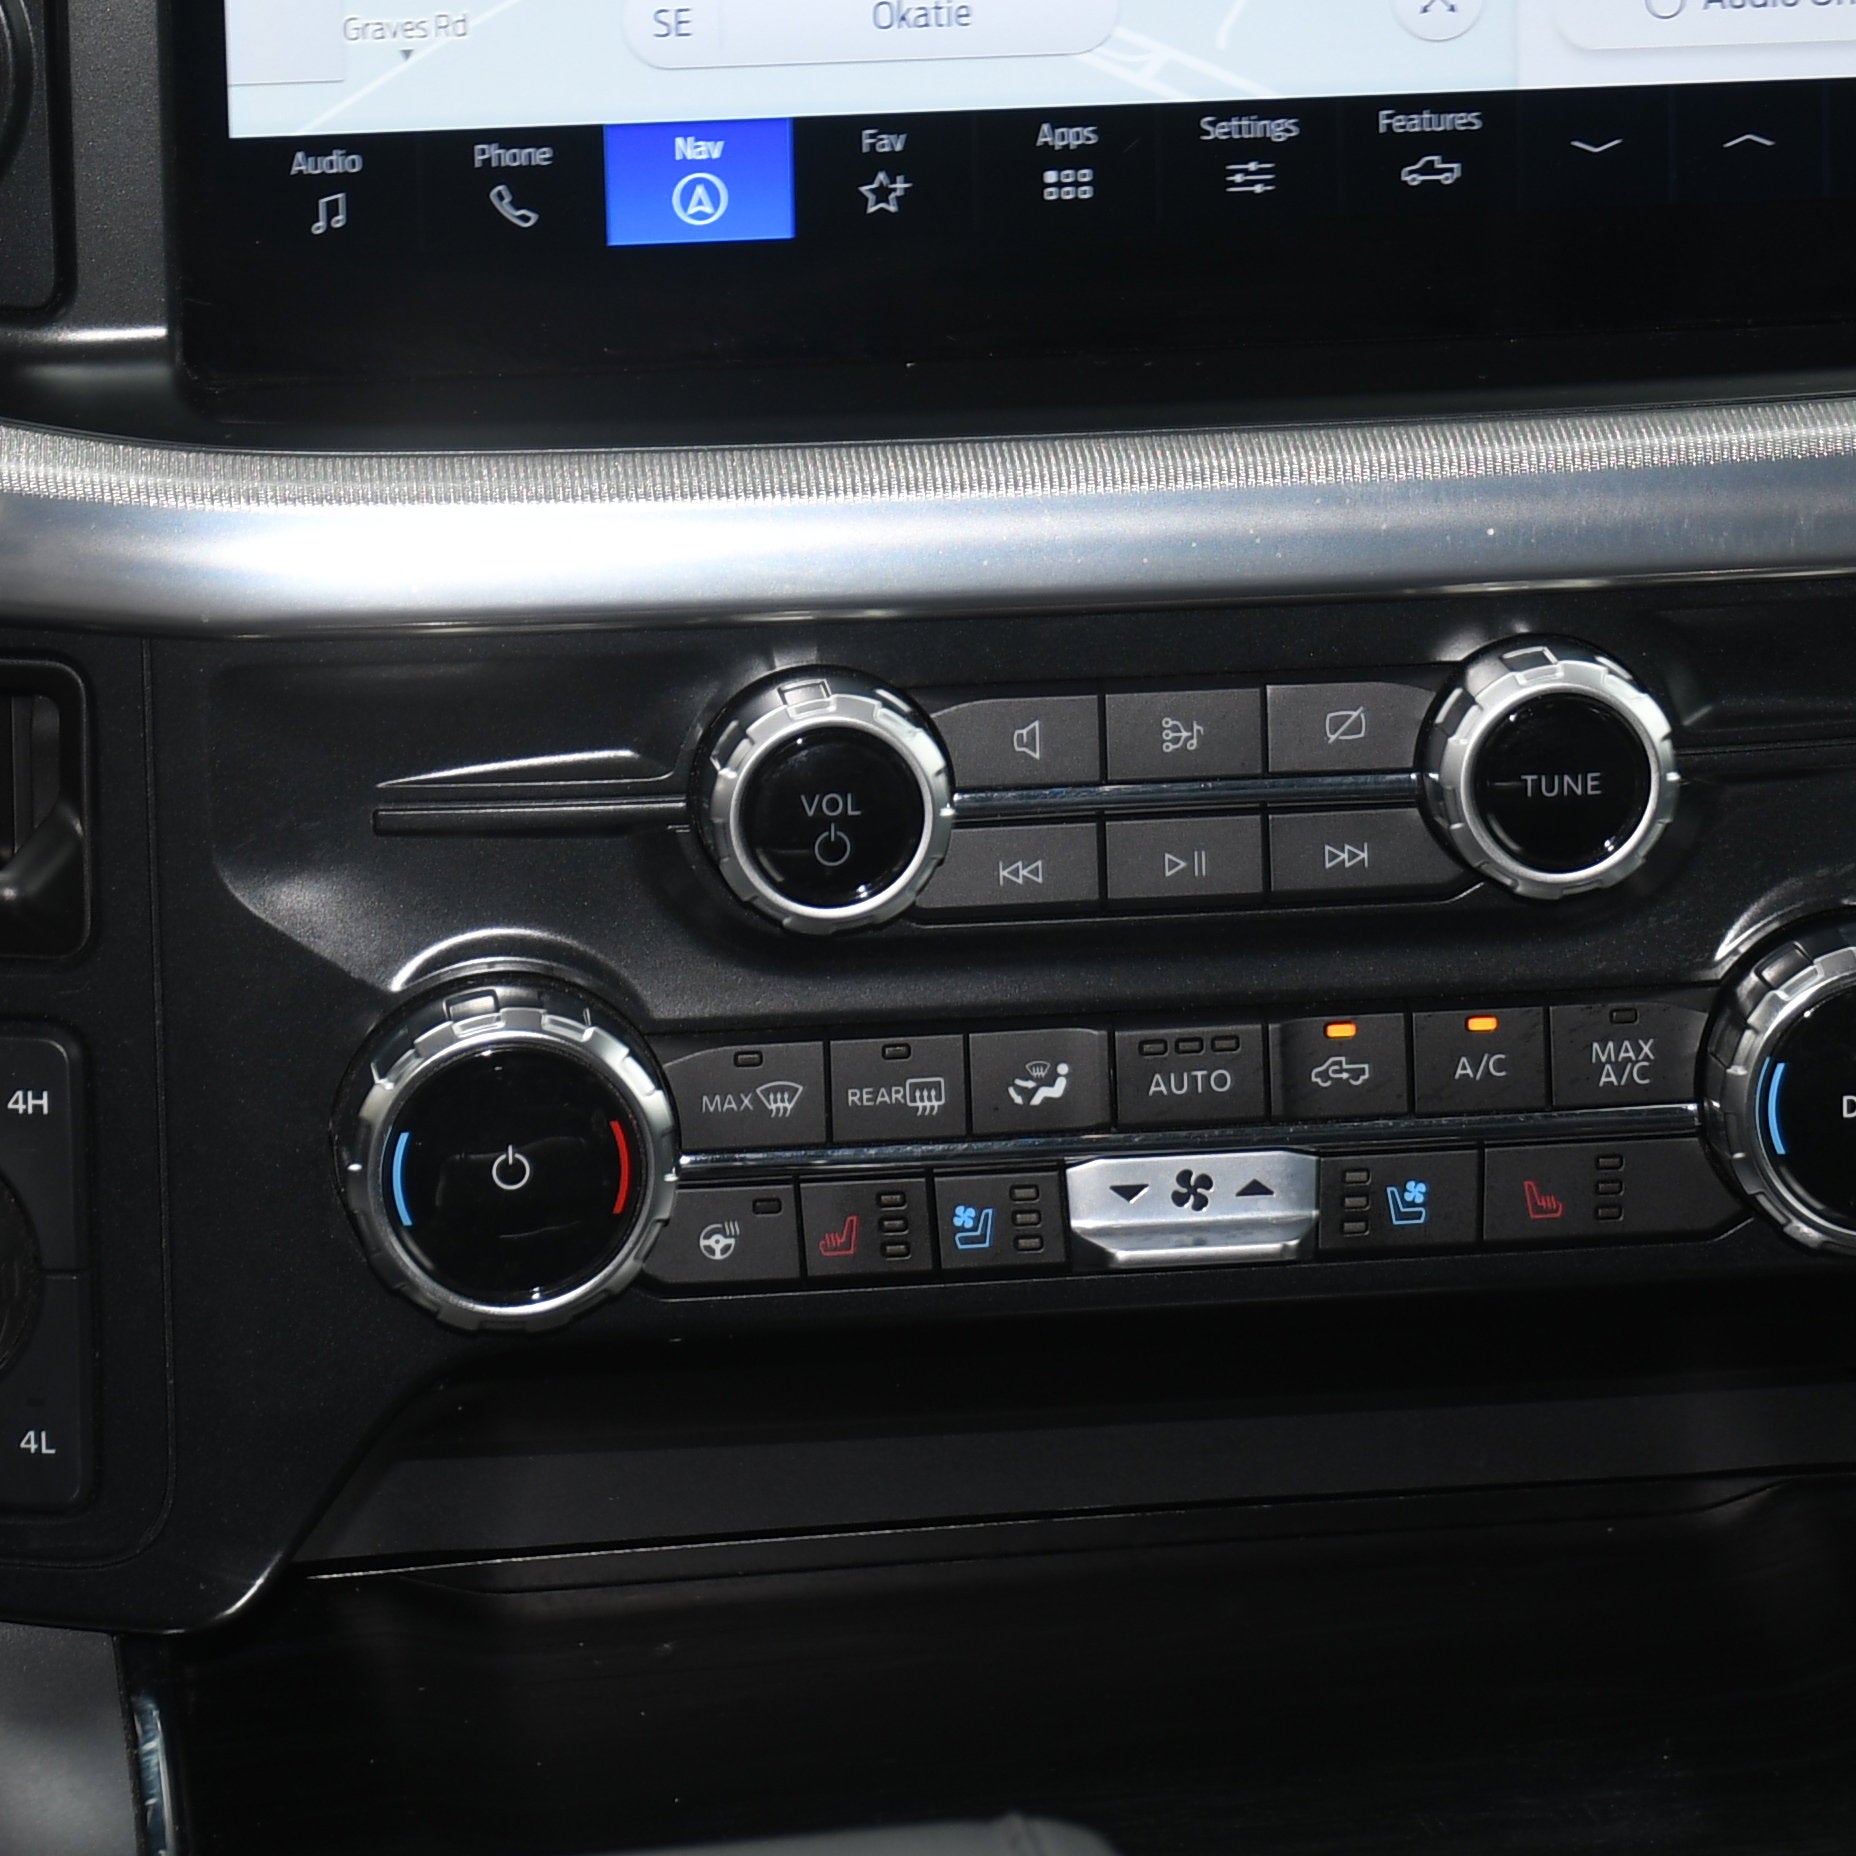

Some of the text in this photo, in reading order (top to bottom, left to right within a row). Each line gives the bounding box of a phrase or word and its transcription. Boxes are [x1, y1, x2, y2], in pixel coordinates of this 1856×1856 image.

[343, 13, 468, 41] Graves Rd
[653, 9, 693, 39] SE
[873, 0, 973, 30] Okatie
[1200, 114, 1300, 144] Settings
[1379, 108, 1483, 135] Features
[675, 136, 724, 161] Nav
[862, 128, 907, 154] Fav
[1036, 122, 1099, 150] Apps
[291, 150, 363, 176] Audio
[475, 142, 553, 168] Phone
[1520, 772, 1600, 799] TUNE
[799, 793, 860, 817] VOL
[1591, 1040, 1655, 1064] MAX
[1454, 1053, 1506, 1079] A/C
[1598, 1061, 1651, 1087] A/C
[1149, 1070, 1232, 1096] AUTO
[7, 1091, 49, 1114] 4H
[703, 1092, 754, 1113] MAX
[849, 1086, 904, 1107] REAR
[20, 1431, 56, 1454] 4L
